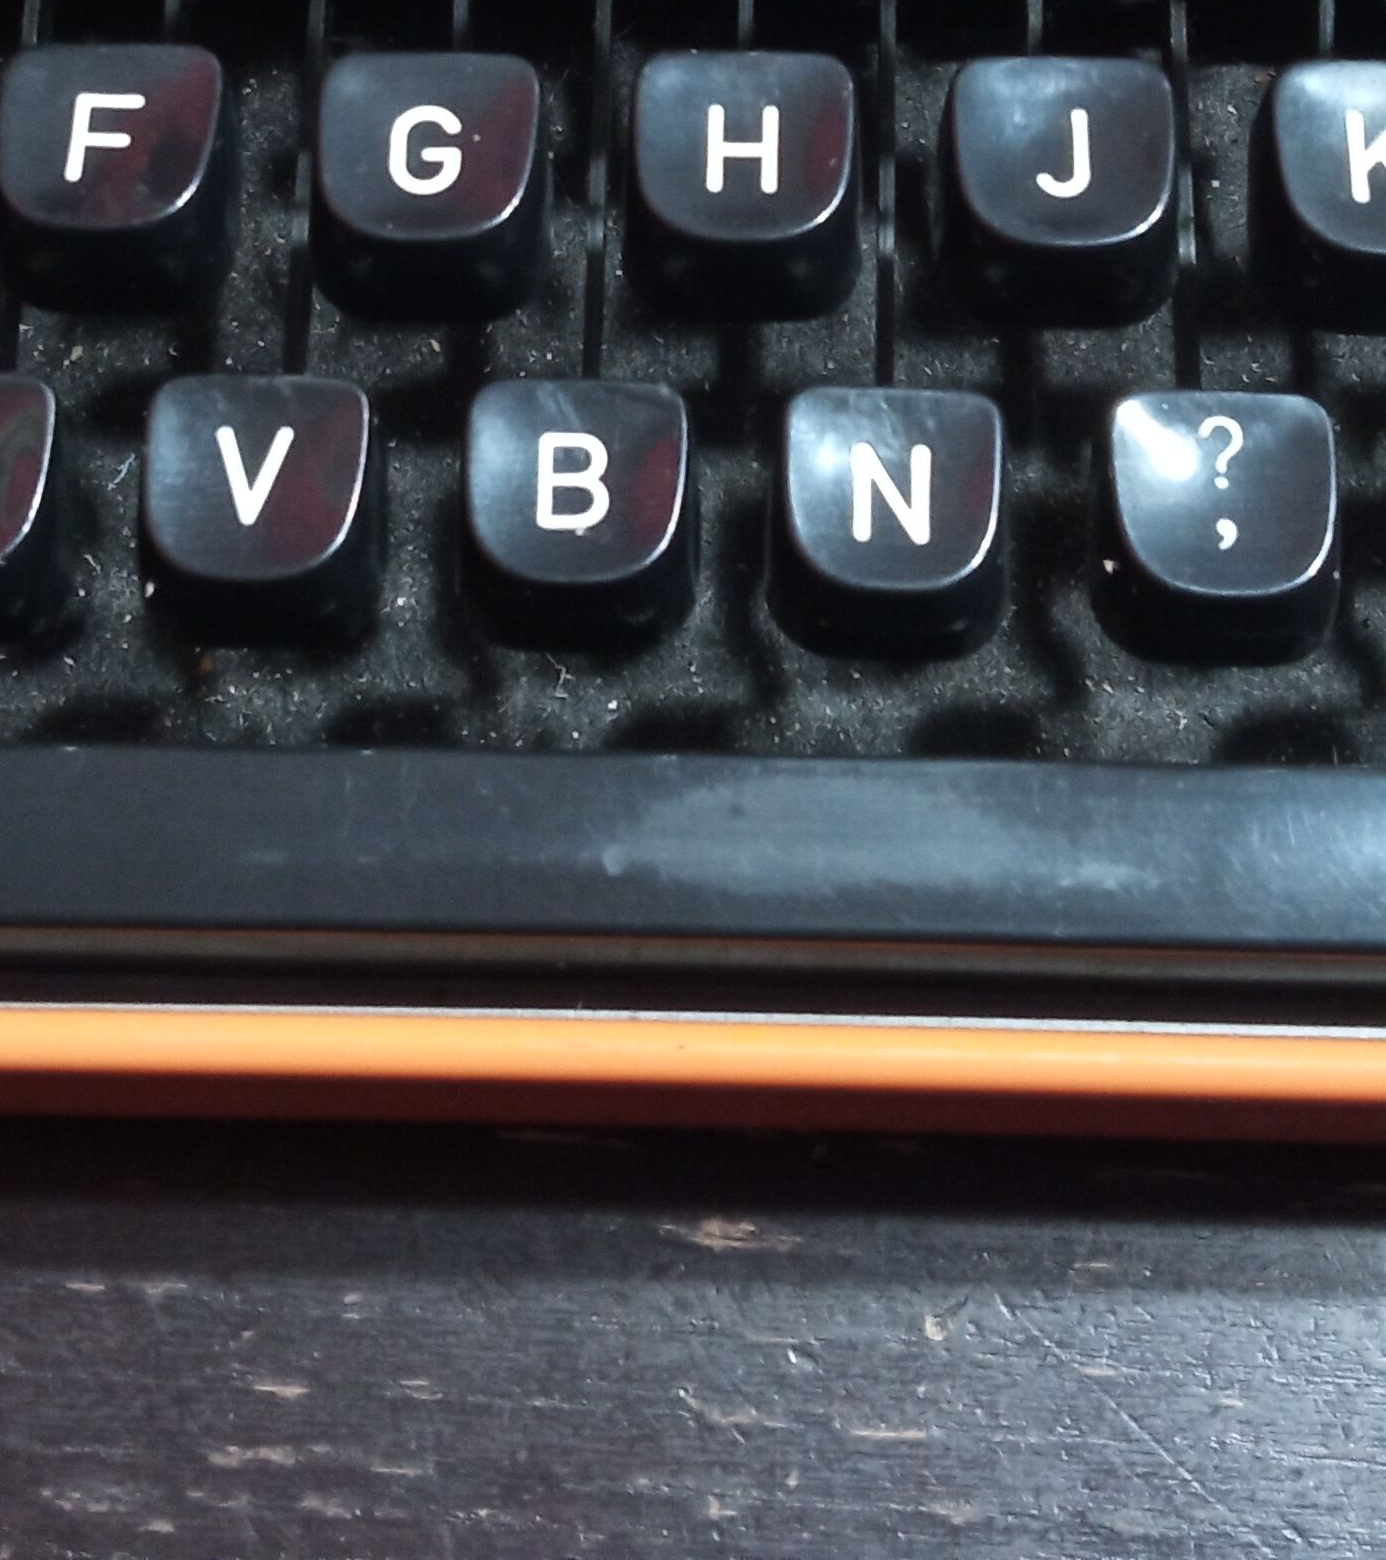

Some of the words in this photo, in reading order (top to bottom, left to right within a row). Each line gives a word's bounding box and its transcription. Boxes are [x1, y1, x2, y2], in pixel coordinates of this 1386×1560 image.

[62, 91, 147, 184] F
[387, 104, 463, 196] G
[704, 102, 781, 195] H
[1034, 107, 1093, 199] J
[214, 424, 296, 527] V
[534, 430, 611, 532] B
[848, 441, 933, 548] N
[1197, 414, 1245, 490] ?
